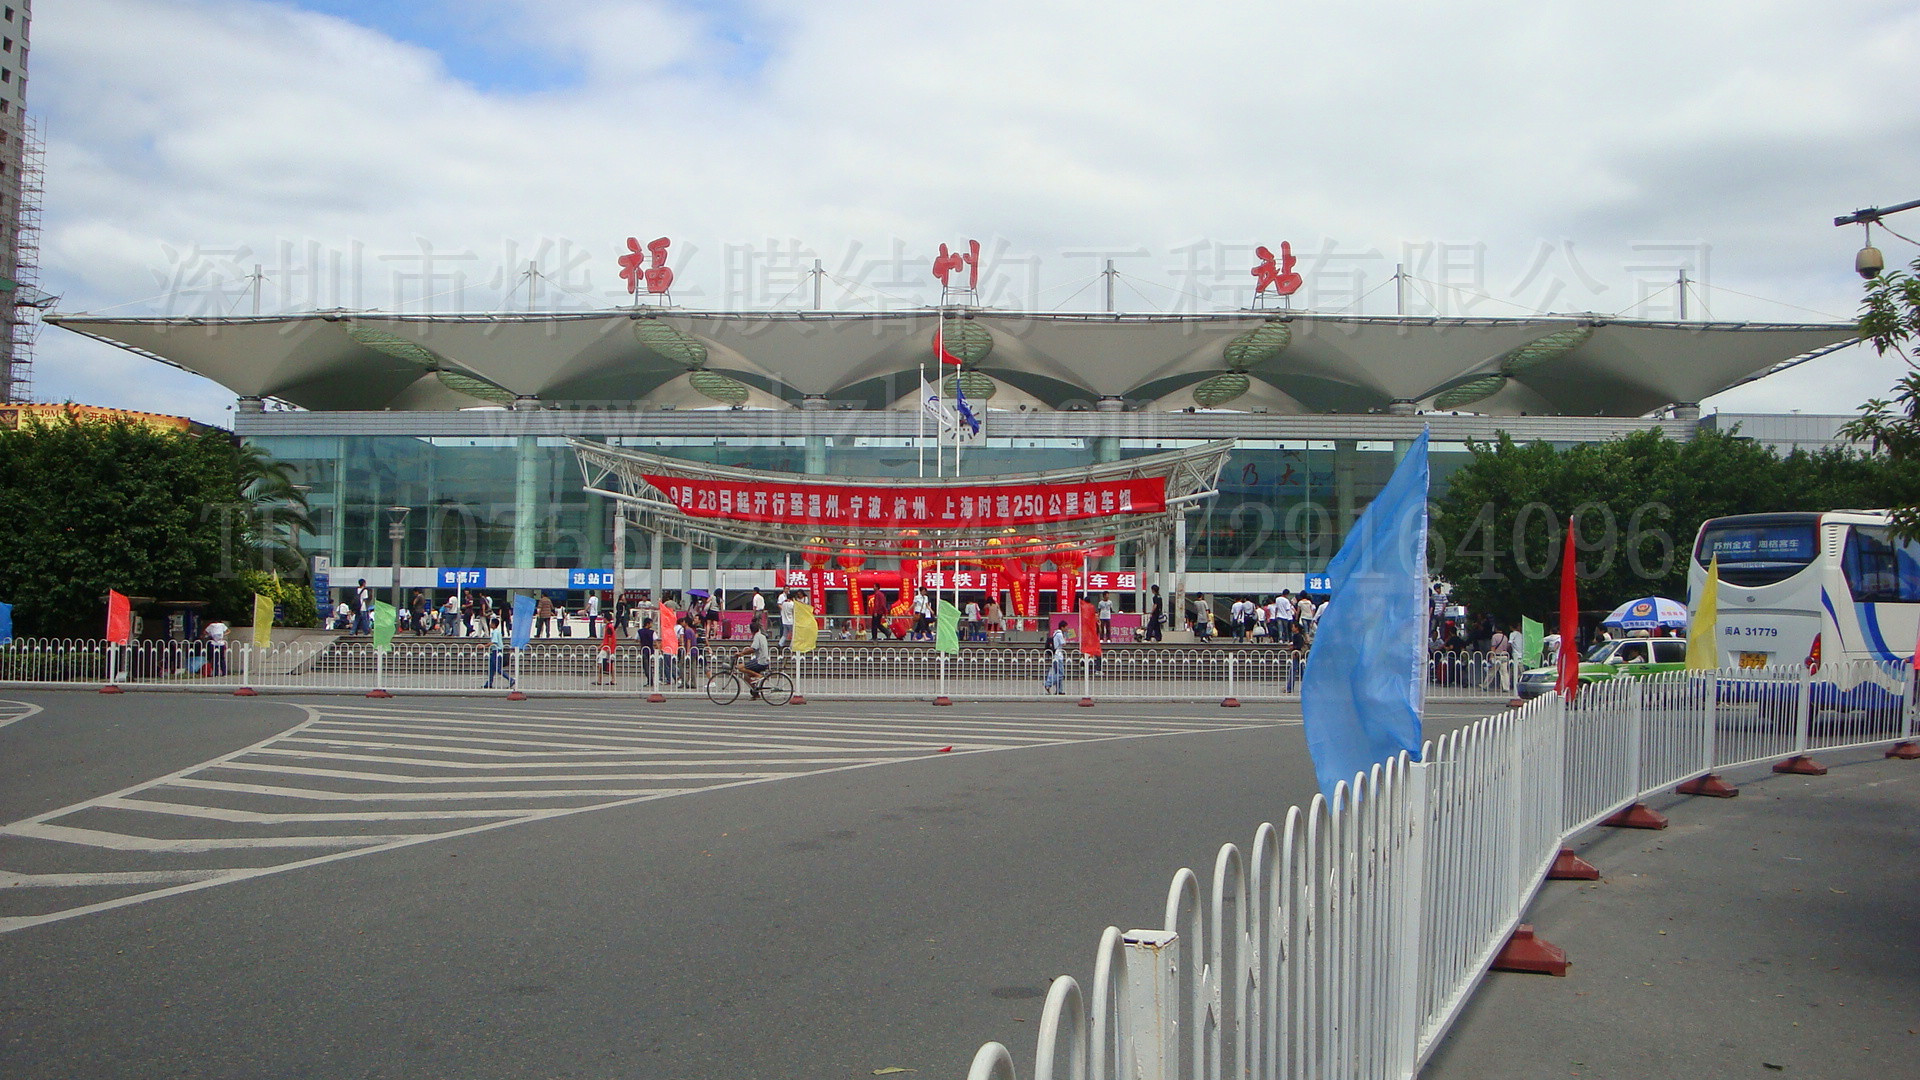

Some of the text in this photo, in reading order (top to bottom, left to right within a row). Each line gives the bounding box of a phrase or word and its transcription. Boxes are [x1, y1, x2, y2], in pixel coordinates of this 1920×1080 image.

[444, 571, 480, 584] 售票厅
[573, 573, 614, 585] 进站口
[1745, 627, 1778, 637] 31779
